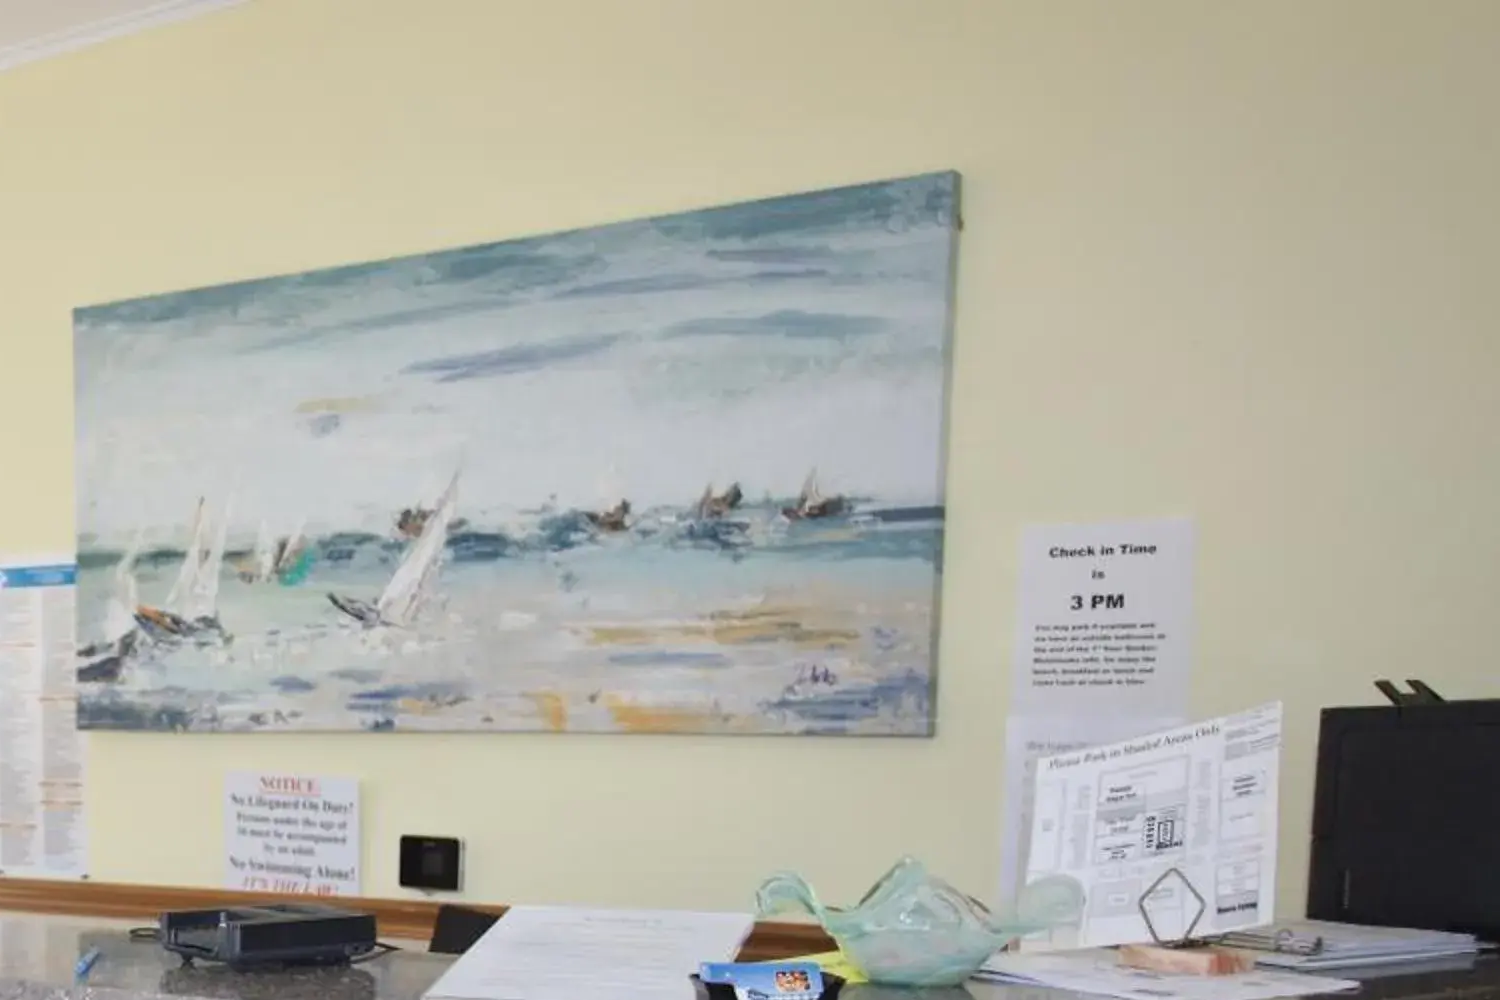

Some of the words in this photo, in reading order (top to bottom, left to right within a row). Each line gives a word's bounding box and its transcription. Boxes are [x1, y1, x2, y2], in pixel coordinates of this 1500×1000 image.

[1048, 545, 1096, 558] Check
[1100, 545, 1114, 555] in
[1119, 543, 1157, 555] Time
[1091, 569, 1106, 580] is
[1069, 594, 1084, 611] 3
[1090, 594, 1125, 609] PM
[1162, 731, 1195, 748] Areas
[259, 775, 319, 793] NOTICE
[248, 796, 300, 811] Lifeguard
[301, 799, 320, 810] On
[248, 859, 313, 879] Swimming
